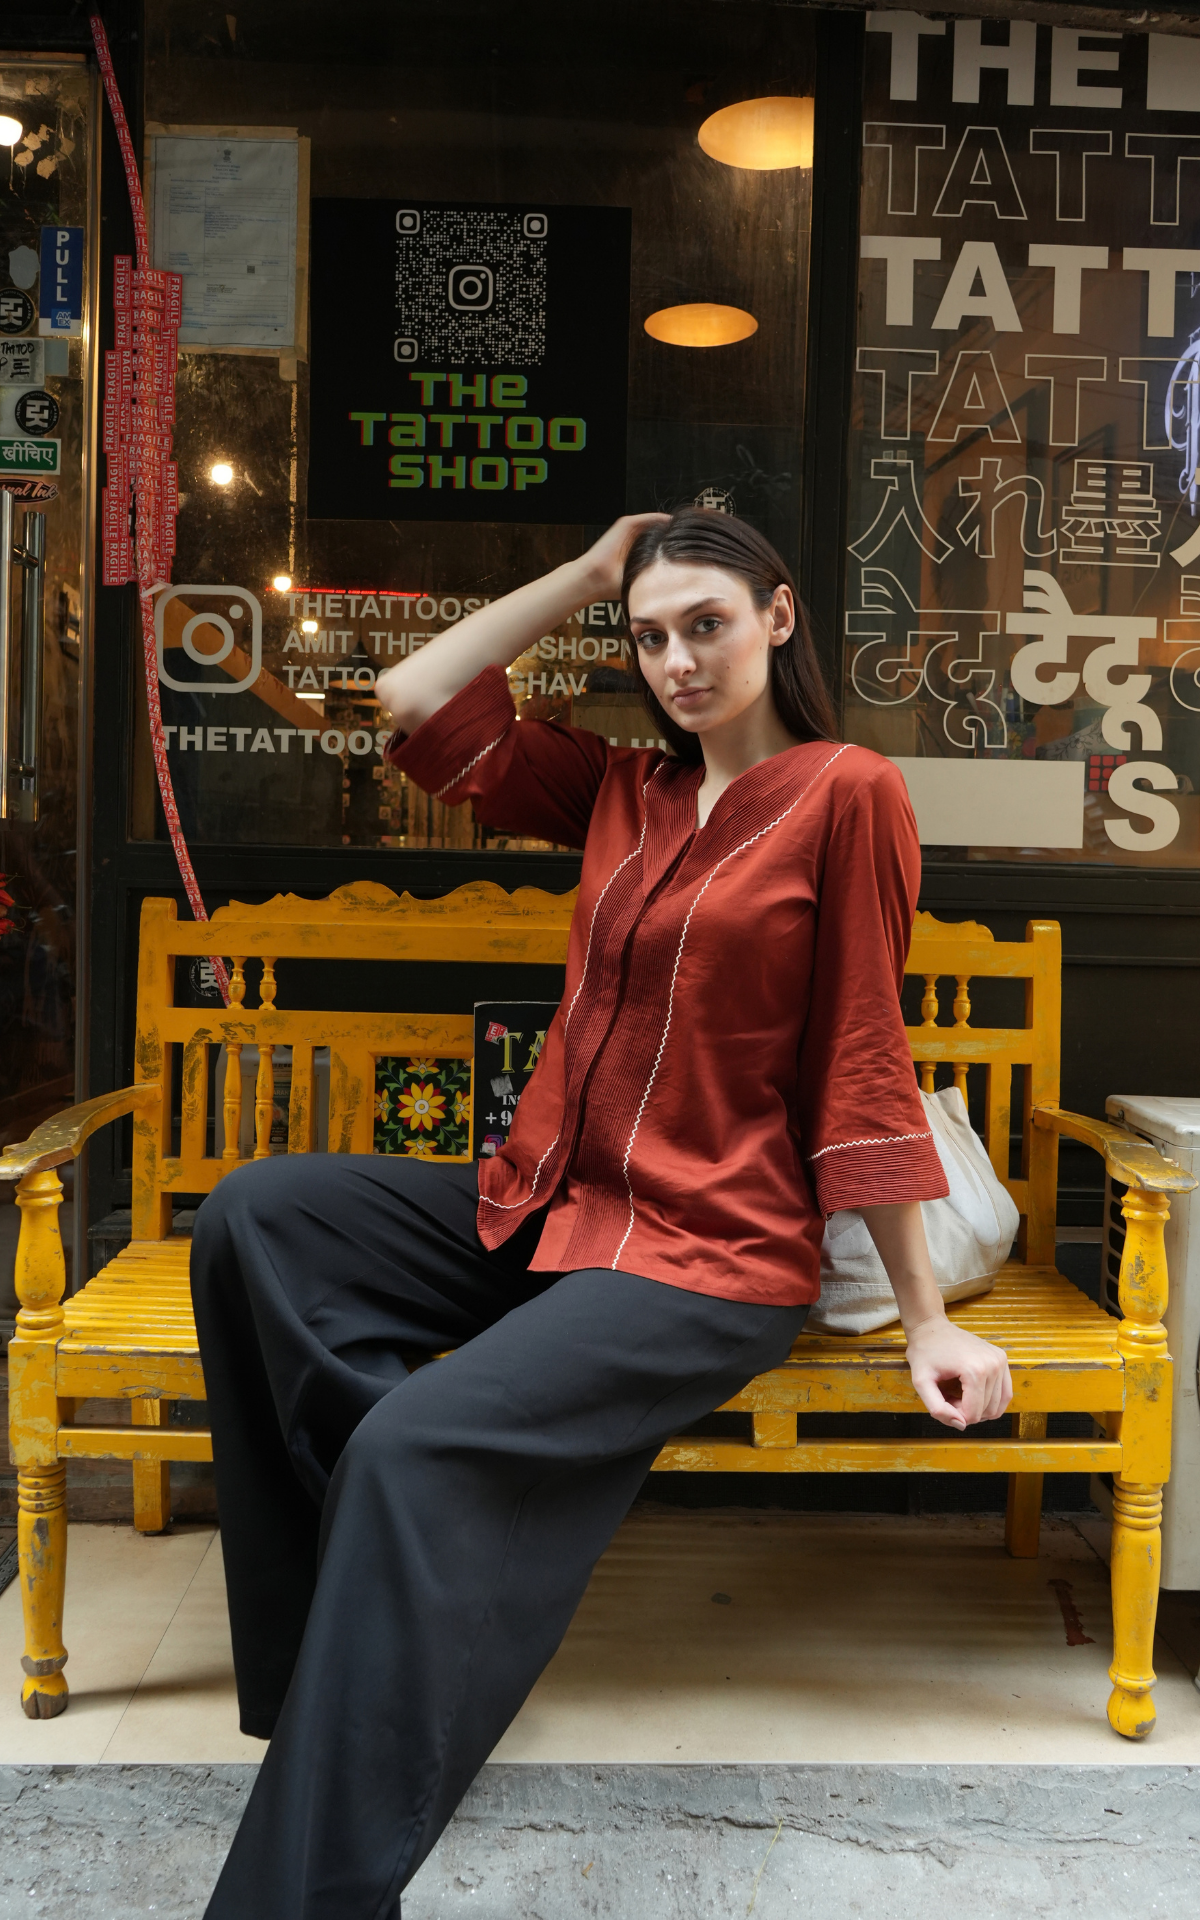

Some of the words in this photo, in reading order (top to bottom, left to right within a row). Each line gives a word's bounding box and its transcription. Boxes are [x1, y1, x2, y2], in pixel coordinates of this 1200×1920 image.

[865, 11, 1123, 108] THE
[56, 231, 70, 302] PULL
[116, 258, 126, 306] FRAGILE
[171, 277, 180, 325] FRAGILE
[154, 344, 163, 391] FRAGILE
[106, 404, 114, 450] FRAGILE
[126, 433, 170, 446] FRAGILE
[167, 465, 176, 512] FRAGILE
[388, 454, 548, 490] SHOP
[282, 665, 387, 692] TATTO
[1005, 569, 1163, 752] टैटू
